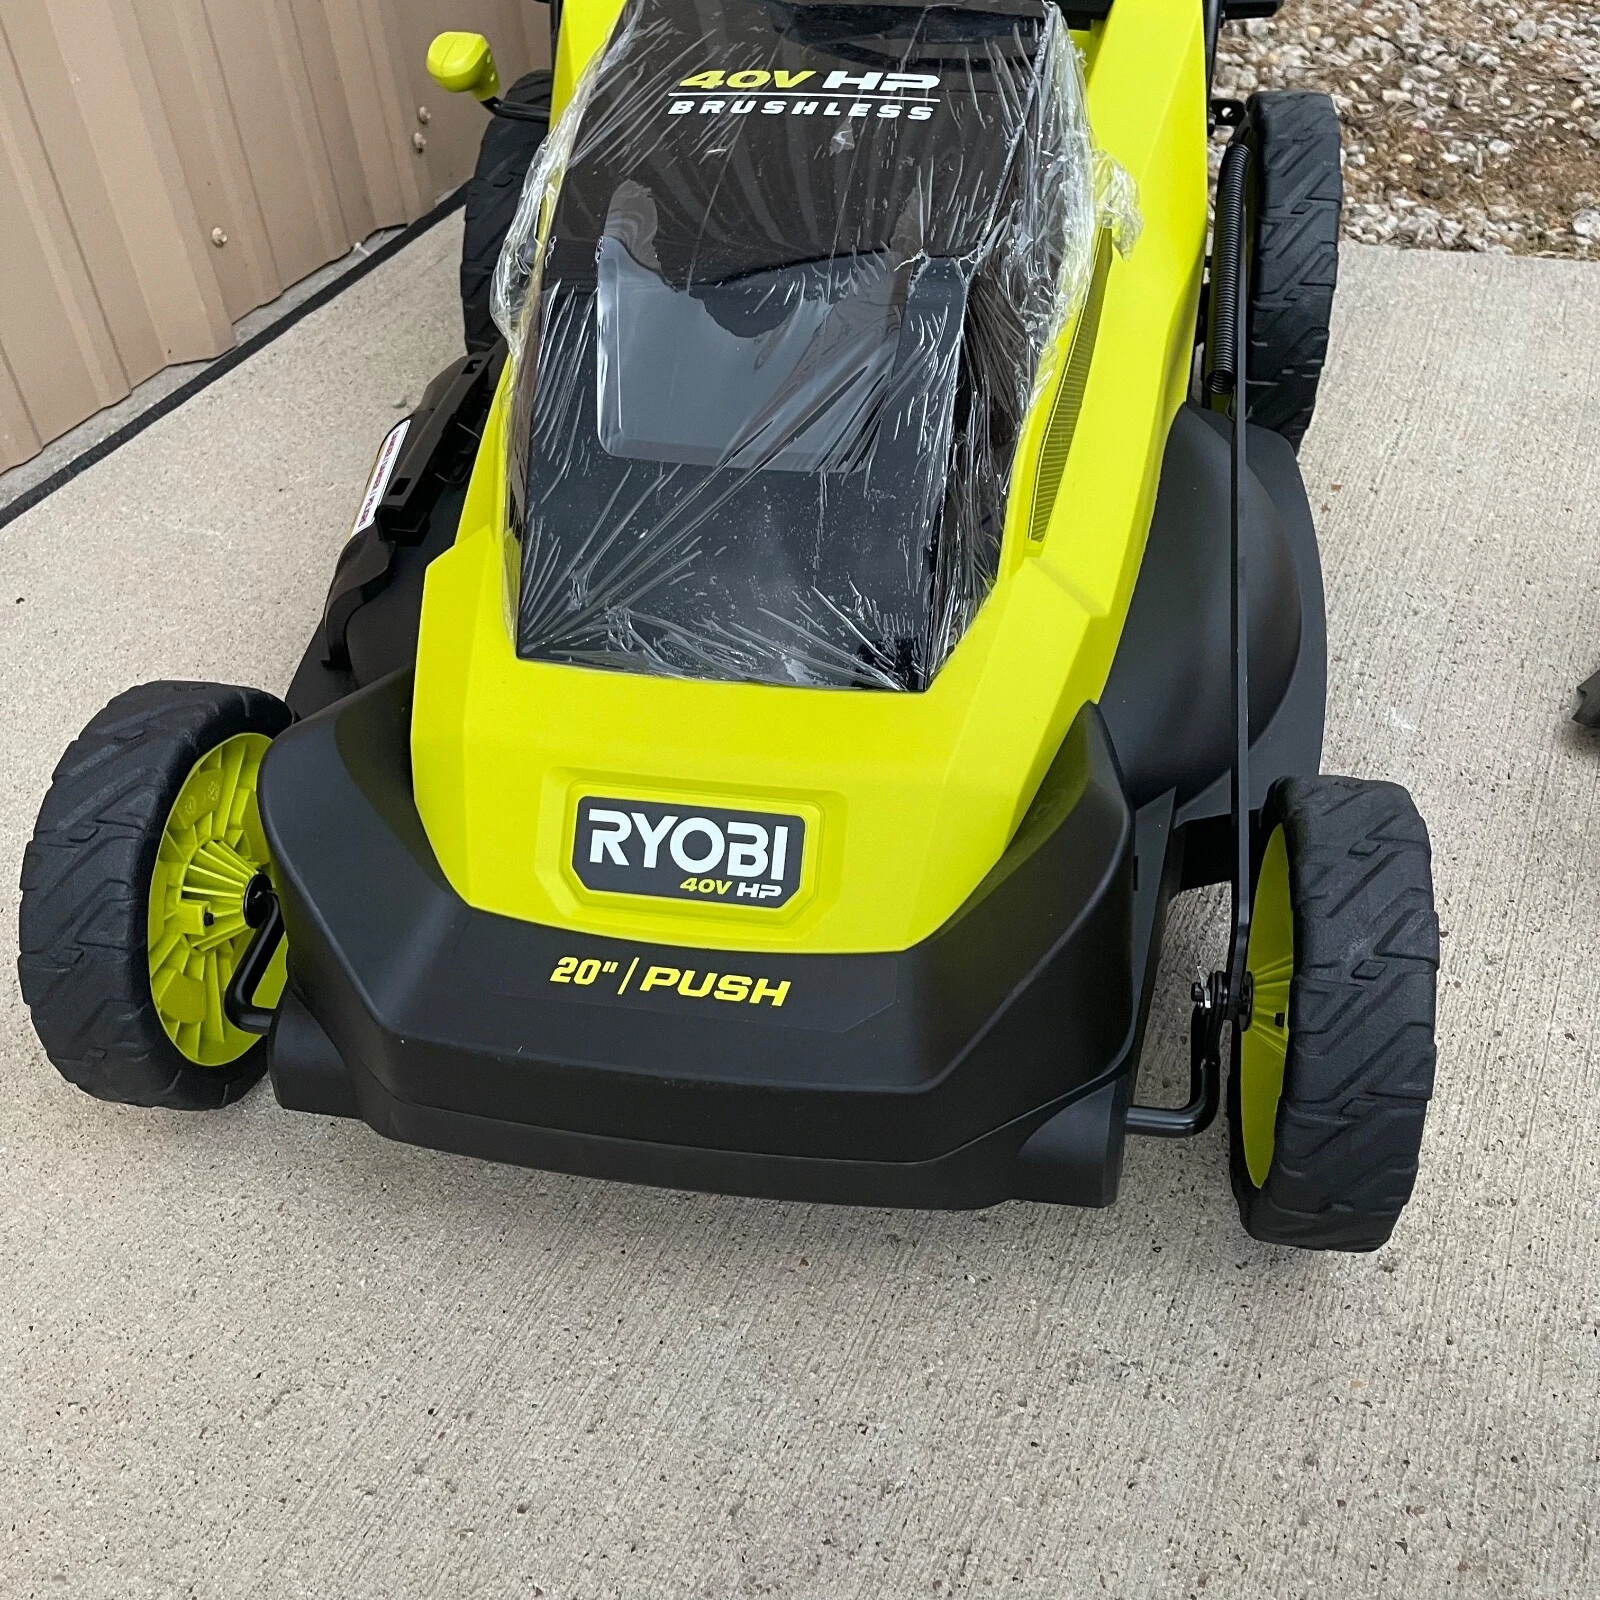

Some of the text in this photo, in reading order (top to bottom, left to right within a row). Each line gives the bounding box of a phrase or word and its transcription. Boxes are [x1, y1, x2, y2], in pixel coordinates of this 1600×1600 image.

[679, 70, 941, 92] 40V HP
[667, 100, 934, 121] BRUSHLESS
[588, 808, 789, 881] RYOBI
[679, 877, 783, 899] 40V HP
[549, 956, 619, 986] 20"
[639, 965, 792, 1007] PUSH
